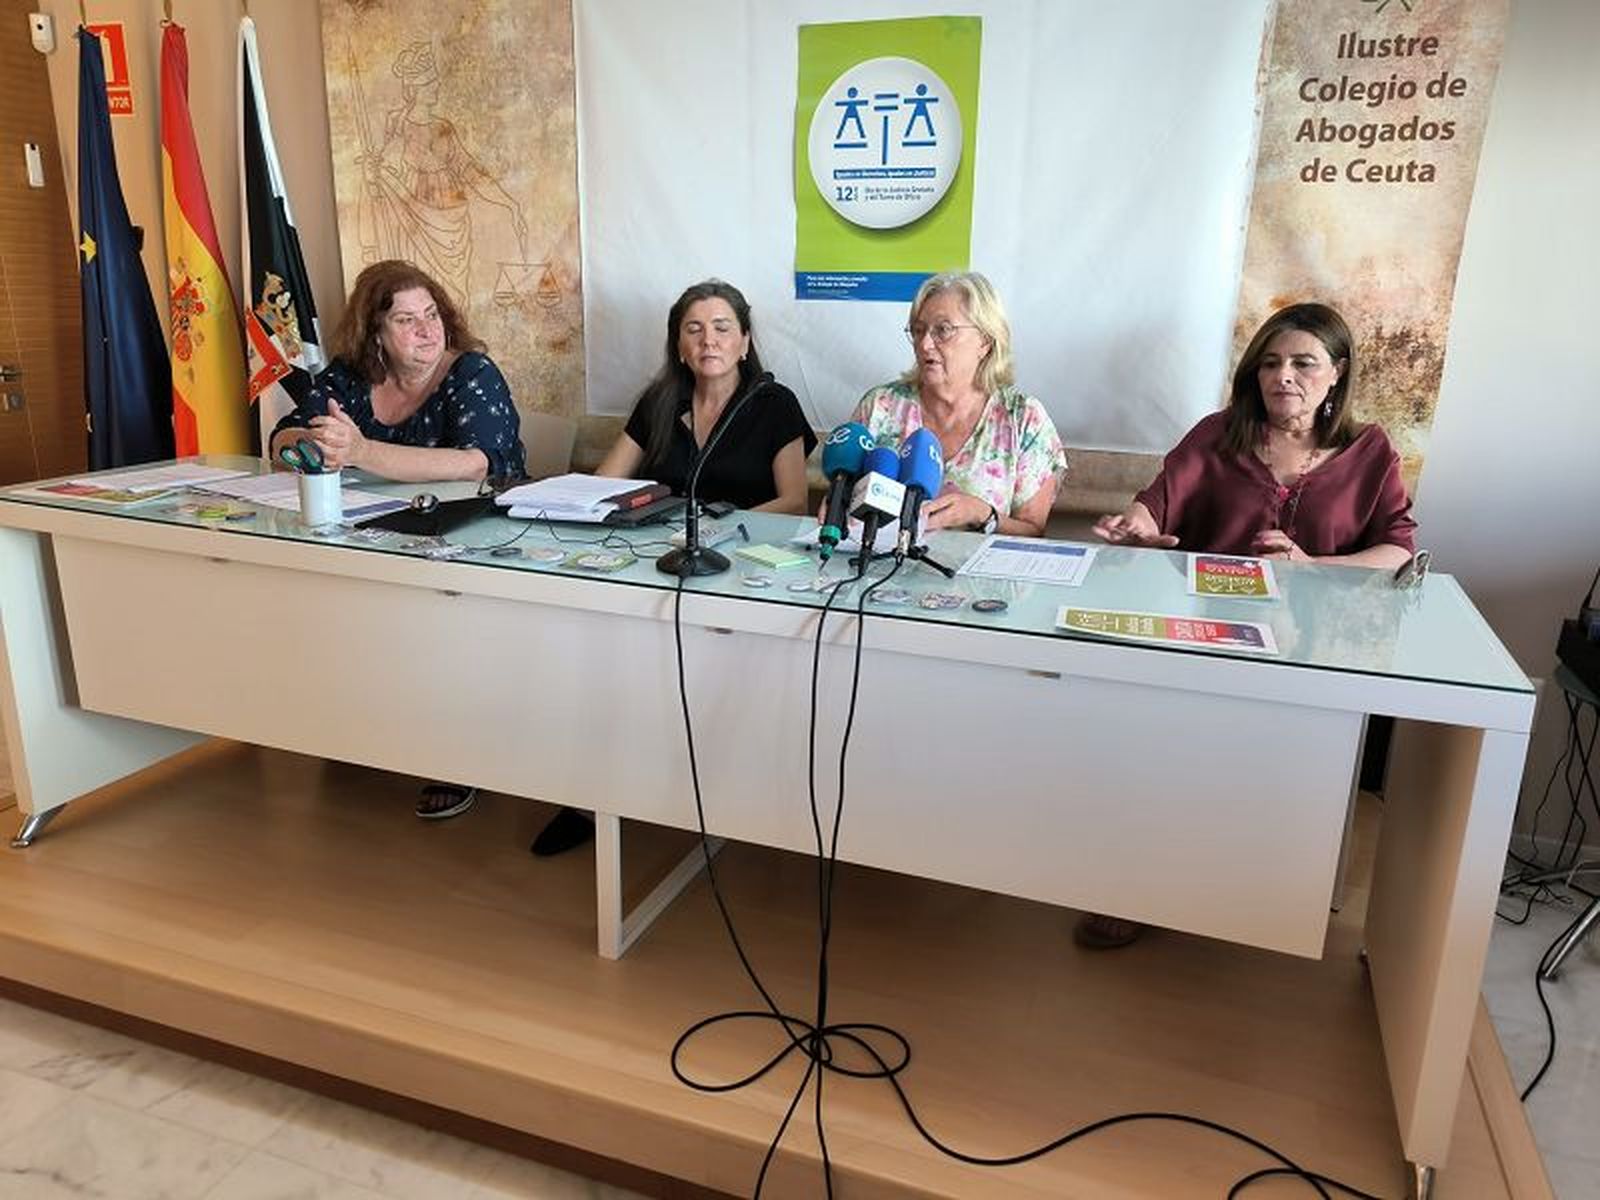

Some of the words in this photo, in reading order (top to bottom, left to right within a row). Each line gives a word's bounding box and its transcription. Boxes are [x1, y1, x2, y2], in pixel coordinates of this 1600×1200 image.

[1337, 32, 1439, 59] Ilustre
[1299, 74, 1417, 107] Colegio
[1426, 72, 1467, 99] de
[1296, 115, 1456, 148] Abogados
[1301, 158, 1337, 183] de
[1346, 159, 1436, 183] Ceuta
[836, 186, 853, 201] 12
